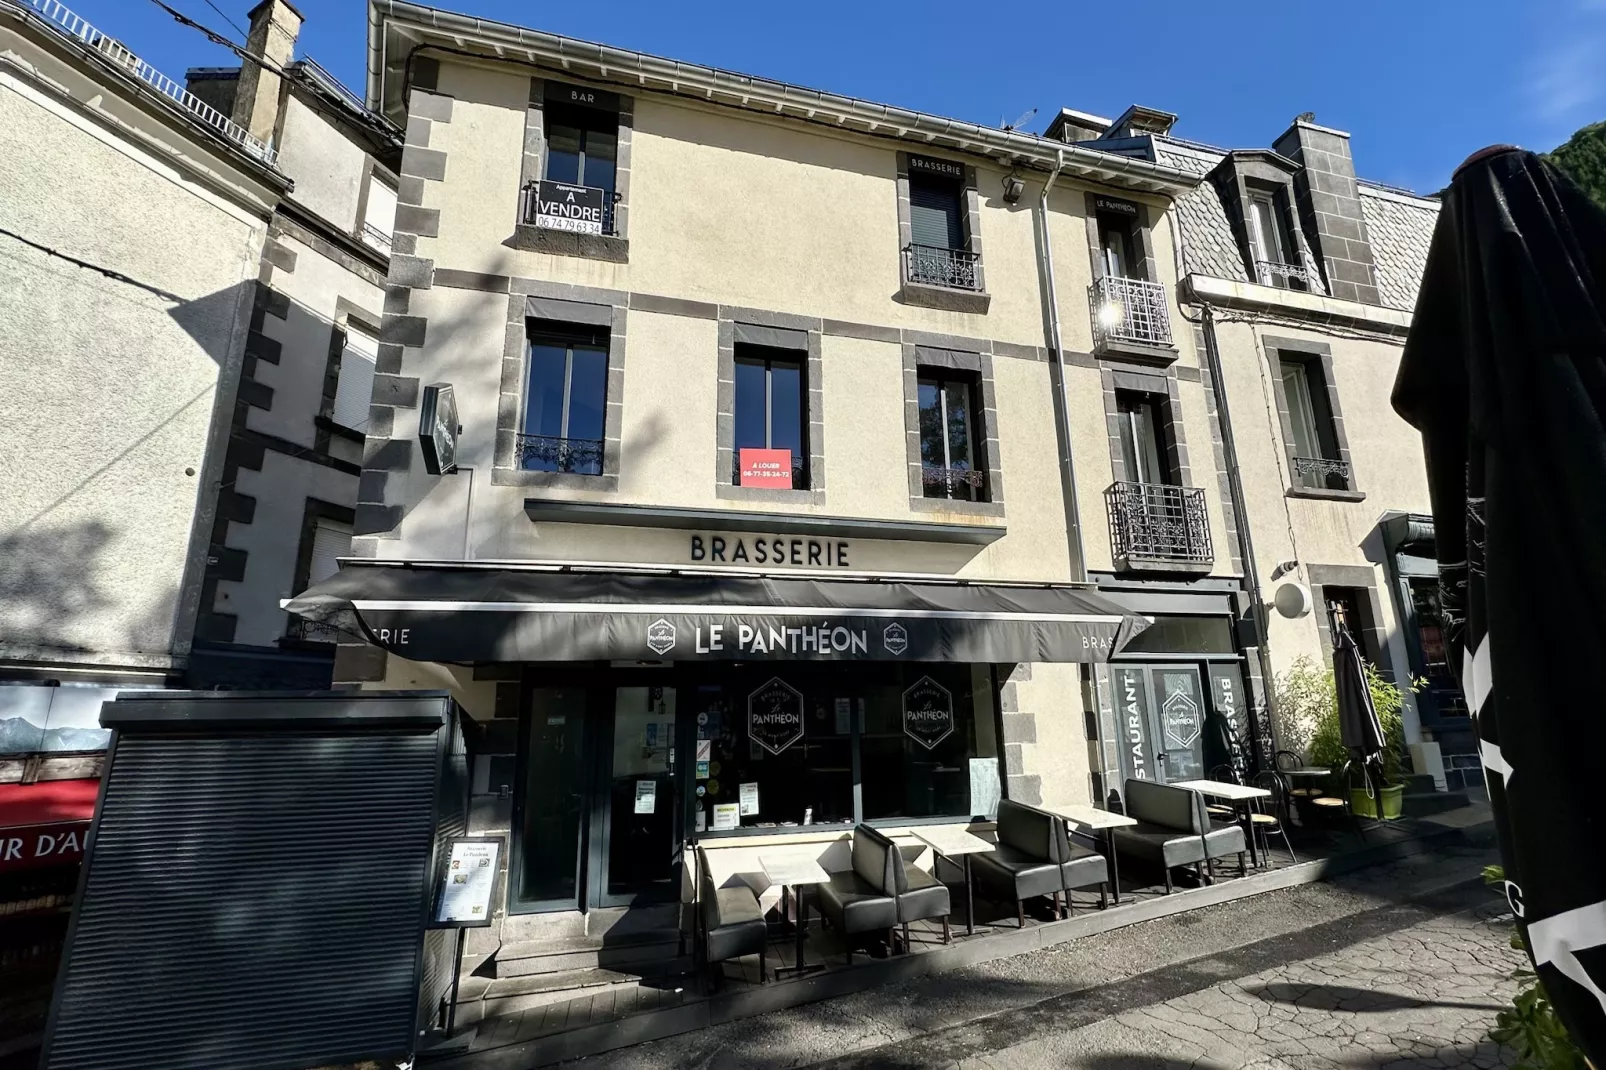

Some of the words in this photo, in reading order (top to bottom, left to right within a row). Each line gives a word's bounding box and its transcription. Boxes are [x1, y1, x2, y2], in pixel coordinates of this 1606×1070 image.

[571, 90, 594, 103] BAR
[911, 158, 961, 175] BRASSERIE
[566, 191, 576, 203] A
[539, 200, 600, 222] VENDRE
[538, 216, 550, 228] 06
[551, 217, 562, 229] 74
[565, 219, 575, 231] 79
[576, 221, 587, 232] 63
[589, 223, 600, 234] 34
[690, 535, 850, 567] BRASSERIE
[372, 628, 410, 645] RIE
[695, 623, 723, 654] LE
[738, 621, 868, 654] PANTHÉON
[752, 711, 799, 725] PANTHÉON
[907, 709, 949, 721] PANTHÉON
[1124, 674, 1146, 780] STAURANT
[1504, 879, 1525, 918] G
